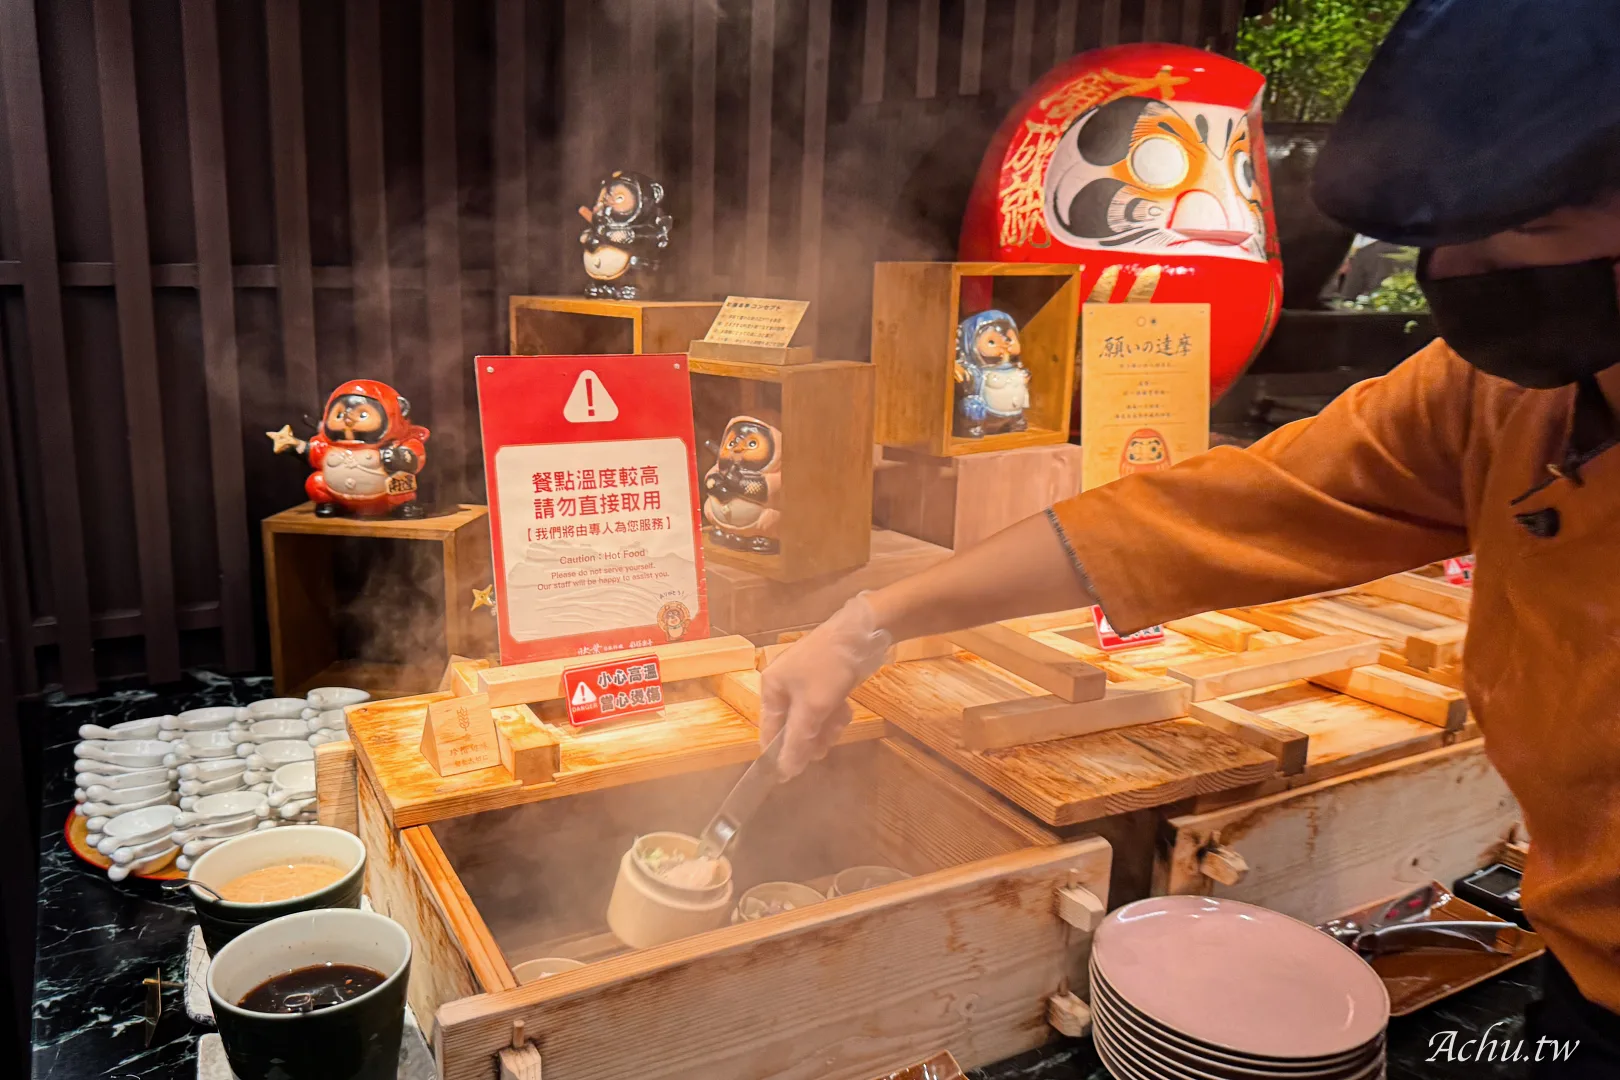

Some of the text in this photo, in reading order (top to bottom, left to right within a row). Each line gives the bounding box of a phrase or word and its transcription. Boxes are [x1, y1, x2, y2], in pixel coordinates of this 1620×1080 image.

[1098, 333, 1192, 358] 願いの達摩
[532, 465, 659, 494] 餐點溫度較高
[534, 490, 661, 520] 請勿直接取用
[560, 554, 596, 565] Caution
[604, 551, 621, 560] Hot
[623, 550, 646, 559] Food
[537, 570, 670, 591] Our staff will be happy to assist you.
[551, 562, 656, 580] Please do not serve yourself.
[597, 662, 659, 688] 小心高溫
[571, 702, 599, 713] DANGER
[599, 686, 662, 712] 當心燙傷
